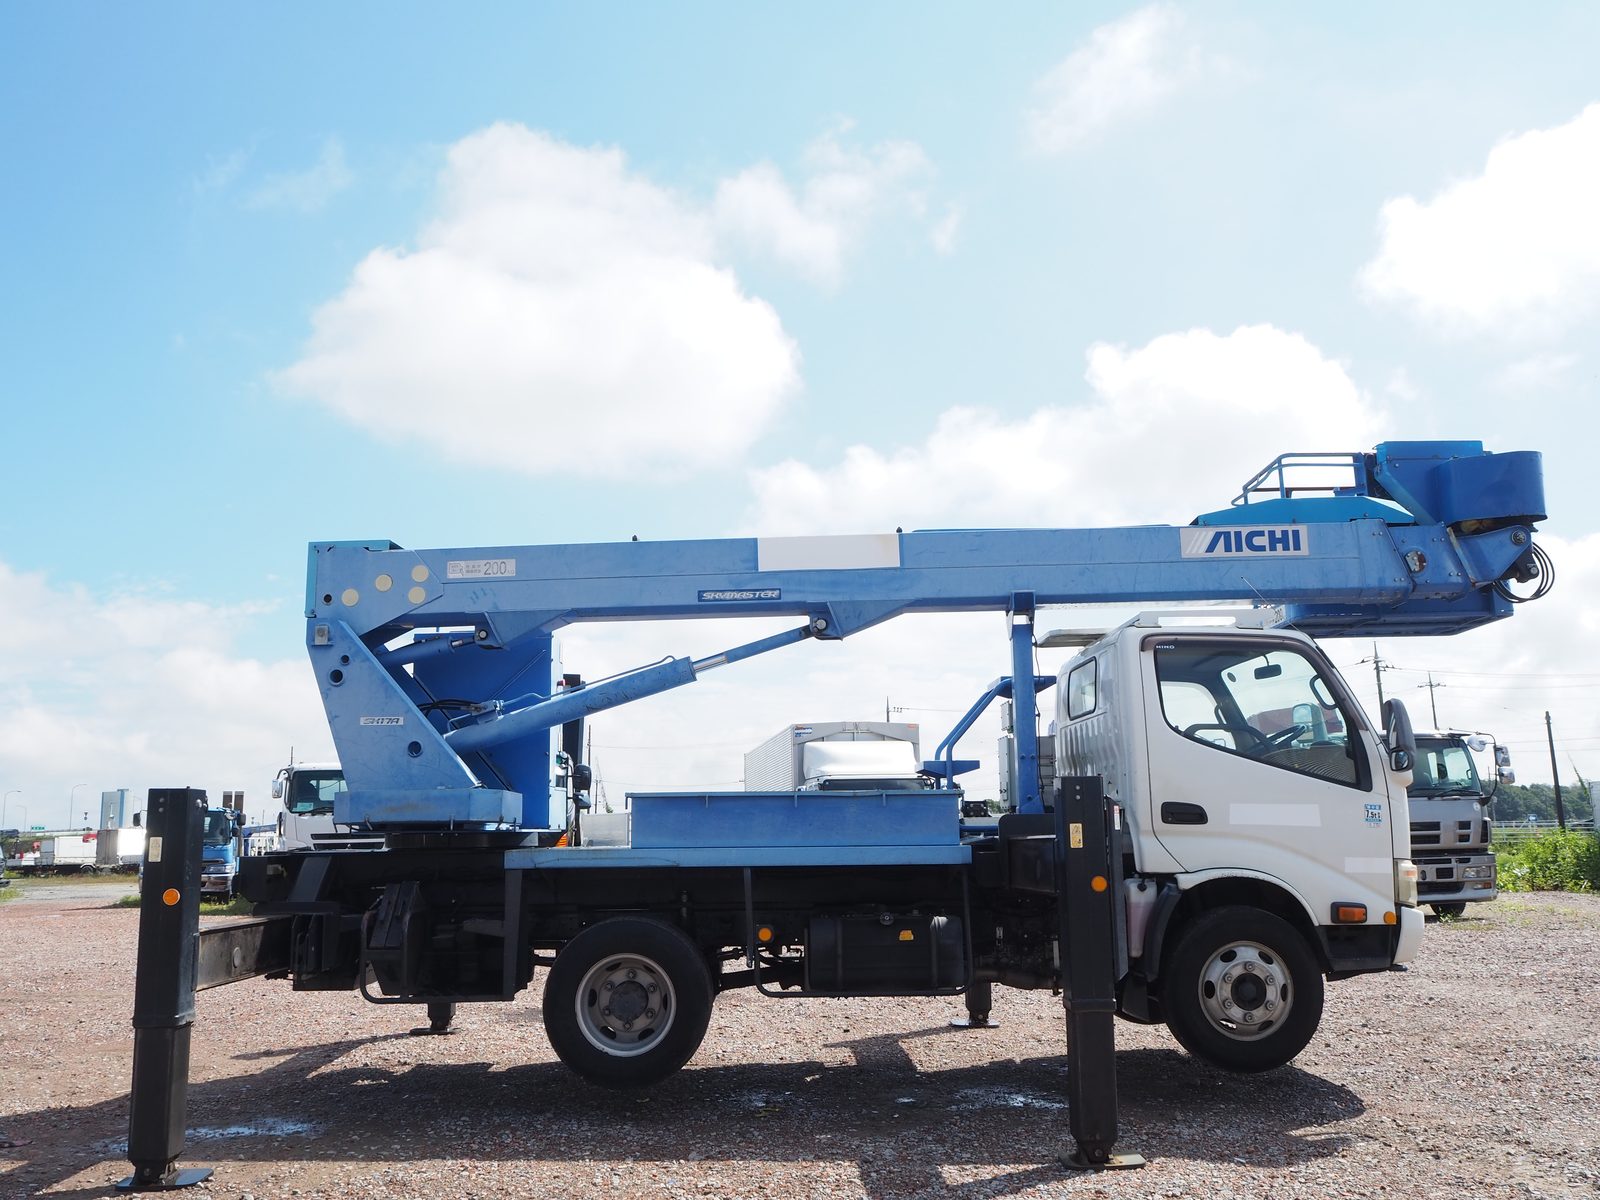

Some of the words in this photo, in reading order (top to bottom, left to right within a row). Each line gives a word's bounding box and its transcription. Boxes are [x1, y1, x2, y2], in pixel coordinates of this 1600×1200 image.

[1205, 529, 1302, 553] AICHI
[483, 561, 507, 575] 200
[702, 590, 779, 600] SKYMASTER
